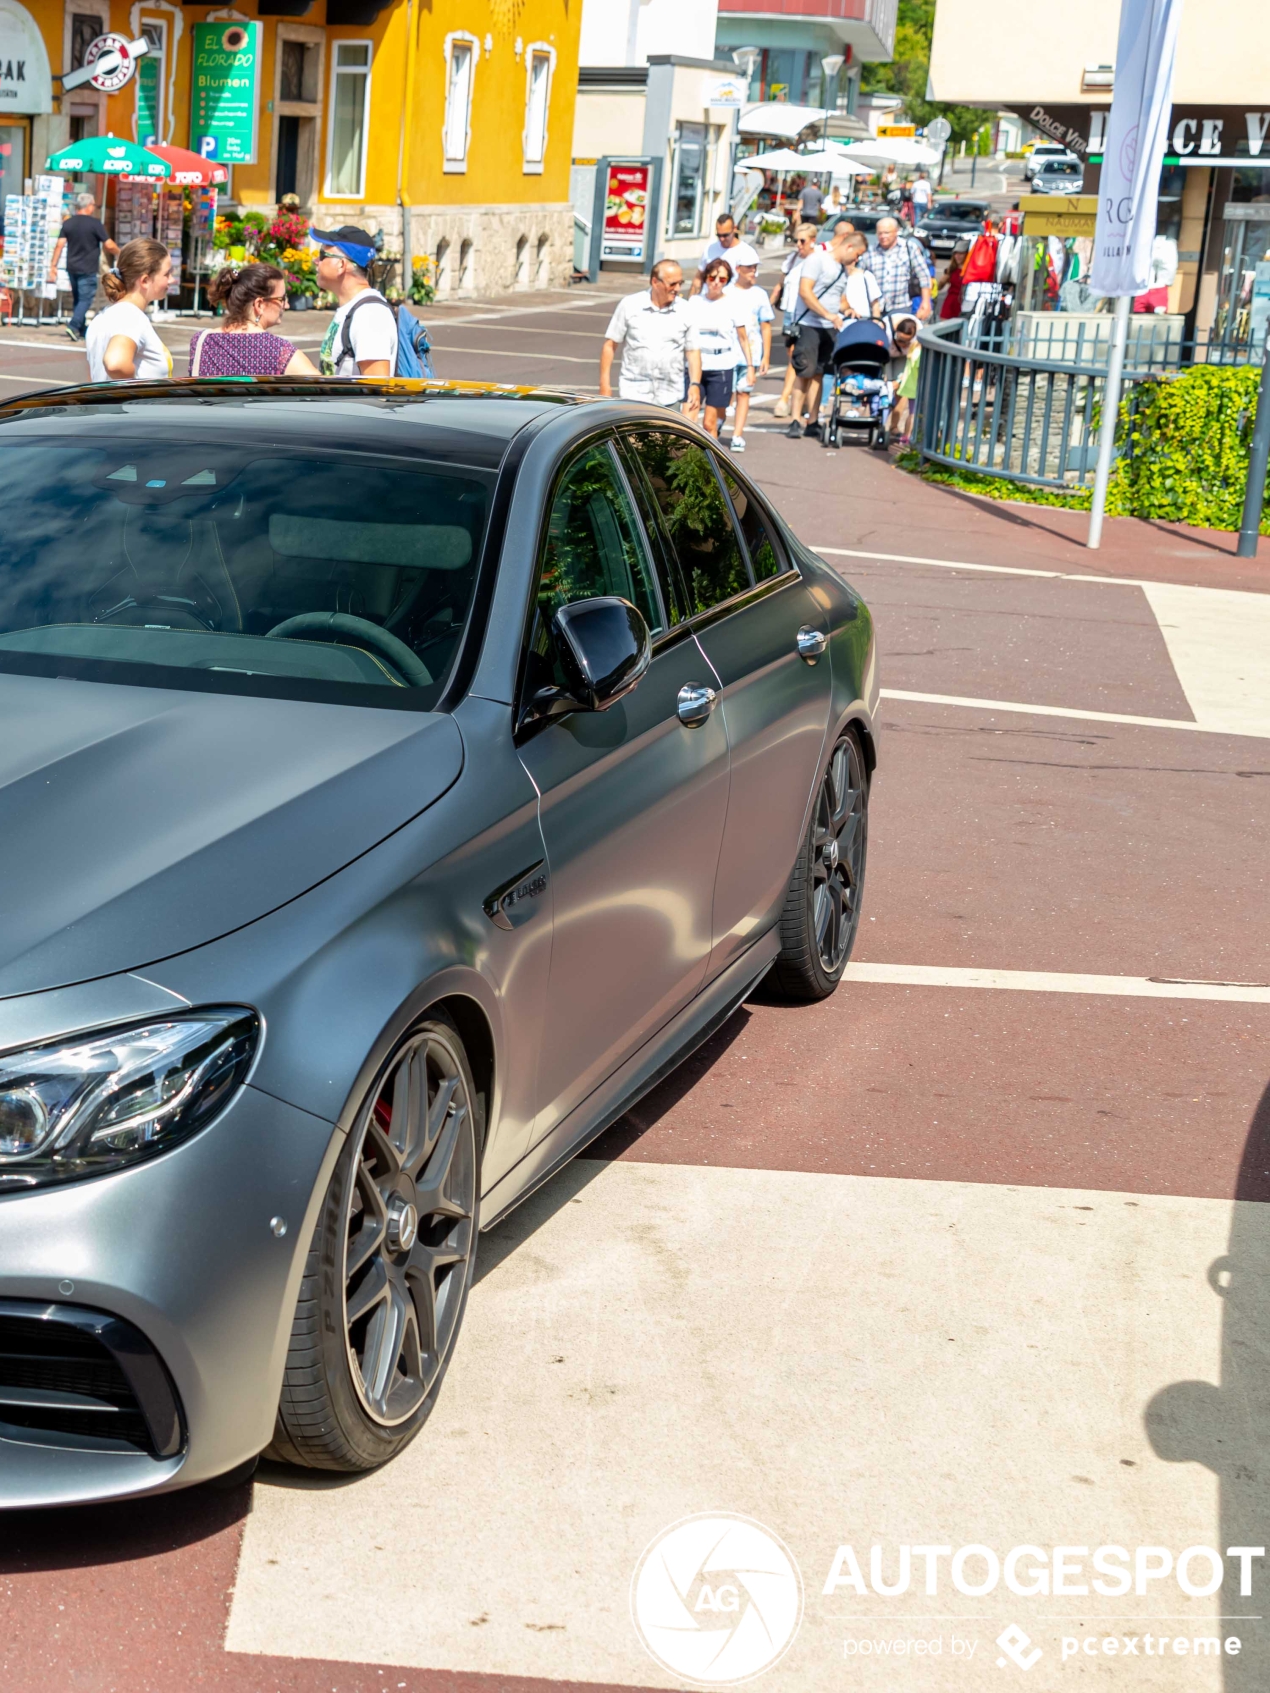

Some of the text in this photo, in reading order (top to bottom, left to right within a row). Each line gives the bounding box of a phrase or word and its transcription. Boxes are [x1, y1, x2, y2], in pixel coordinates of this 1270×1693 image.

[205, 35, 219, 49] EL
[197, 53, 253, 67] FLORADO
[198, 75, 249, 87] Blumen
[1030, 105, 1087, 152] DOLCE VITA
[175, 171, 203, 184] TOTO
[1066, 198, 1081, 212] N
